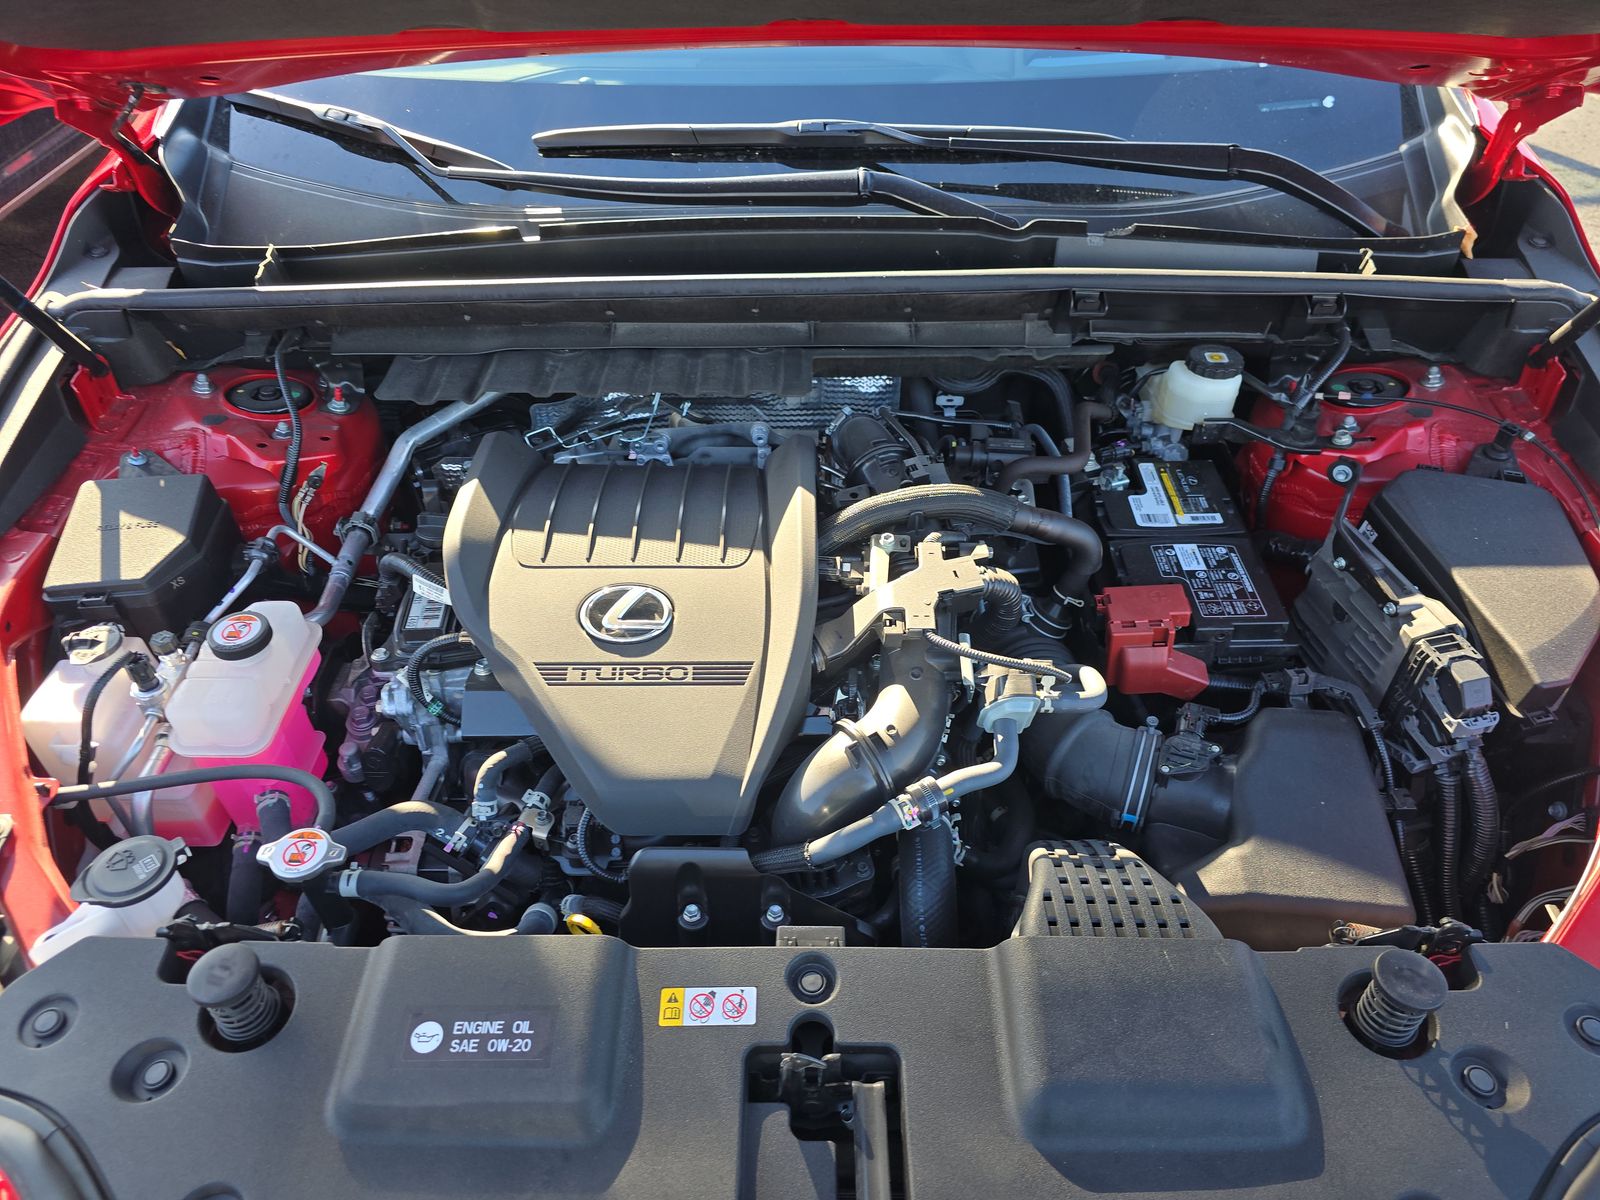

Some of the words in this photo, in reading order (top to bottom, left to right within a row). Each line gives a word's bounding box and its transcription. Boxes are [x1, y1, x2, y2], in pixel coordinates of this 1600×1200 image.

[1175, 469, 1190, 493] LEXUS
[571, 666, 689, 681] TURBO
[453, 1021, 504, 1034] ENGINE
[511, 1021, 535, 1034] OIL
[449, 1039, 480, 1052] SAE
[487, 1038, 532, 1052] 0W-20
